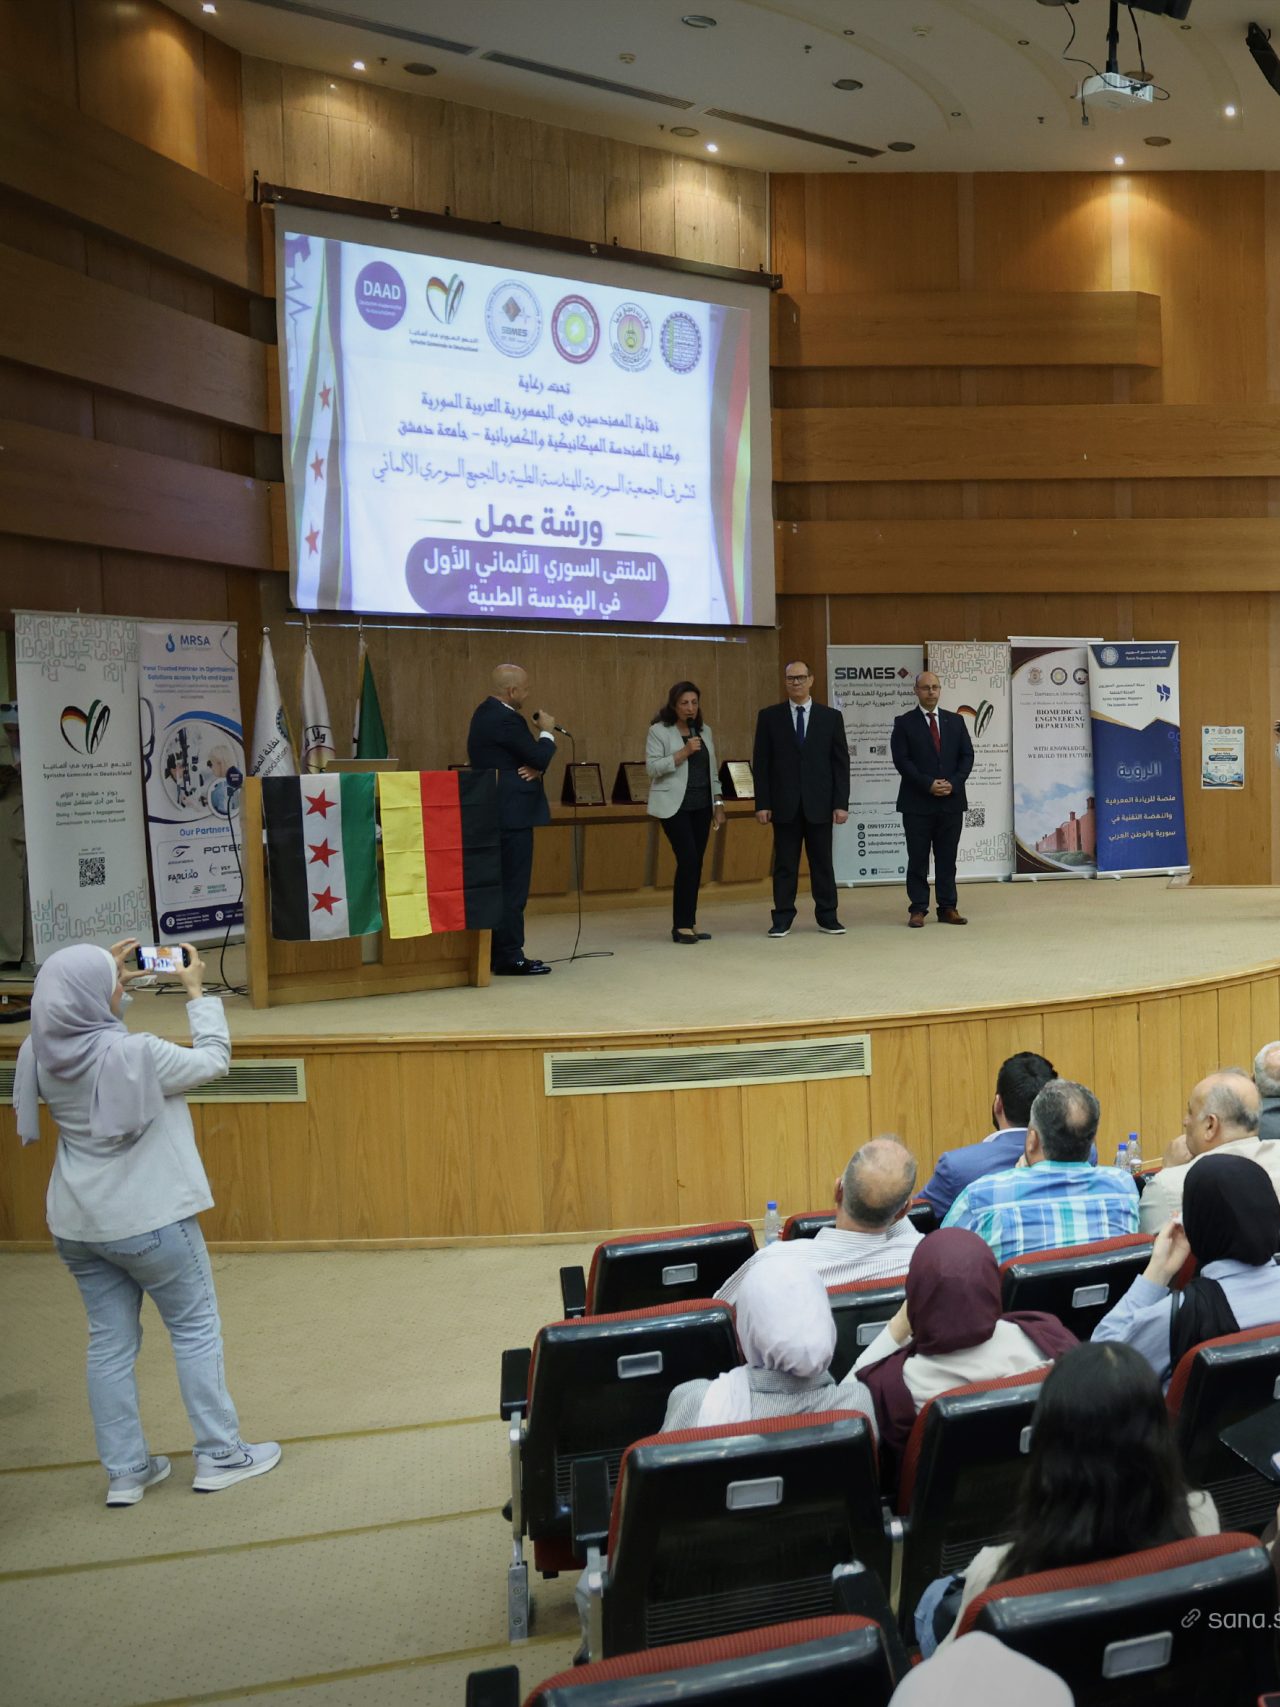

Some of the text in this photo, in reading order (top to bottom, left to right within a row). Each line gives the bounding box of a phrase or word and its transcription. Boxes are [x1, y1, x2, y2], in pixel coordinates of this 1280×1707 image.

[363, 280, 401, 300] DAAD
[518, 374, 571, 395] تحت رعاية
[421, 391, 660, 434] نقابة المهندسين في الجمهورية العربية السورية
[397, 420, 434, 437] دمشق
[437, 422, 469, 441] جامعة
[548, 432, 607, 456] الميكانيكية
[608, 440, 650, 458] الهندسة
[652, 444, 680, 465] وكلية
[419, 456, 465, 486] السوري
[466, 459, 506, 489] والتجمع
[540, 468, 582, 492] للهندسة
[583, 472, 624, 498] السورية
[626, 476, 663, 500] الجمعية
[664, 484, 696, 504] تشرف
[475, 503, 604, 547] ورشة عمل
[423, 544, 657, 585] الملتقى السوري الألماني الأول
[467, 582, 622, 621] في الهندسة الطبية
[180, 635, 211, 646] MRSA
[834, 667, 896, 680] SBMES
[1118, 761, 1161, 780] الرؤية
[179, 826, 231, 837] Our Partners
